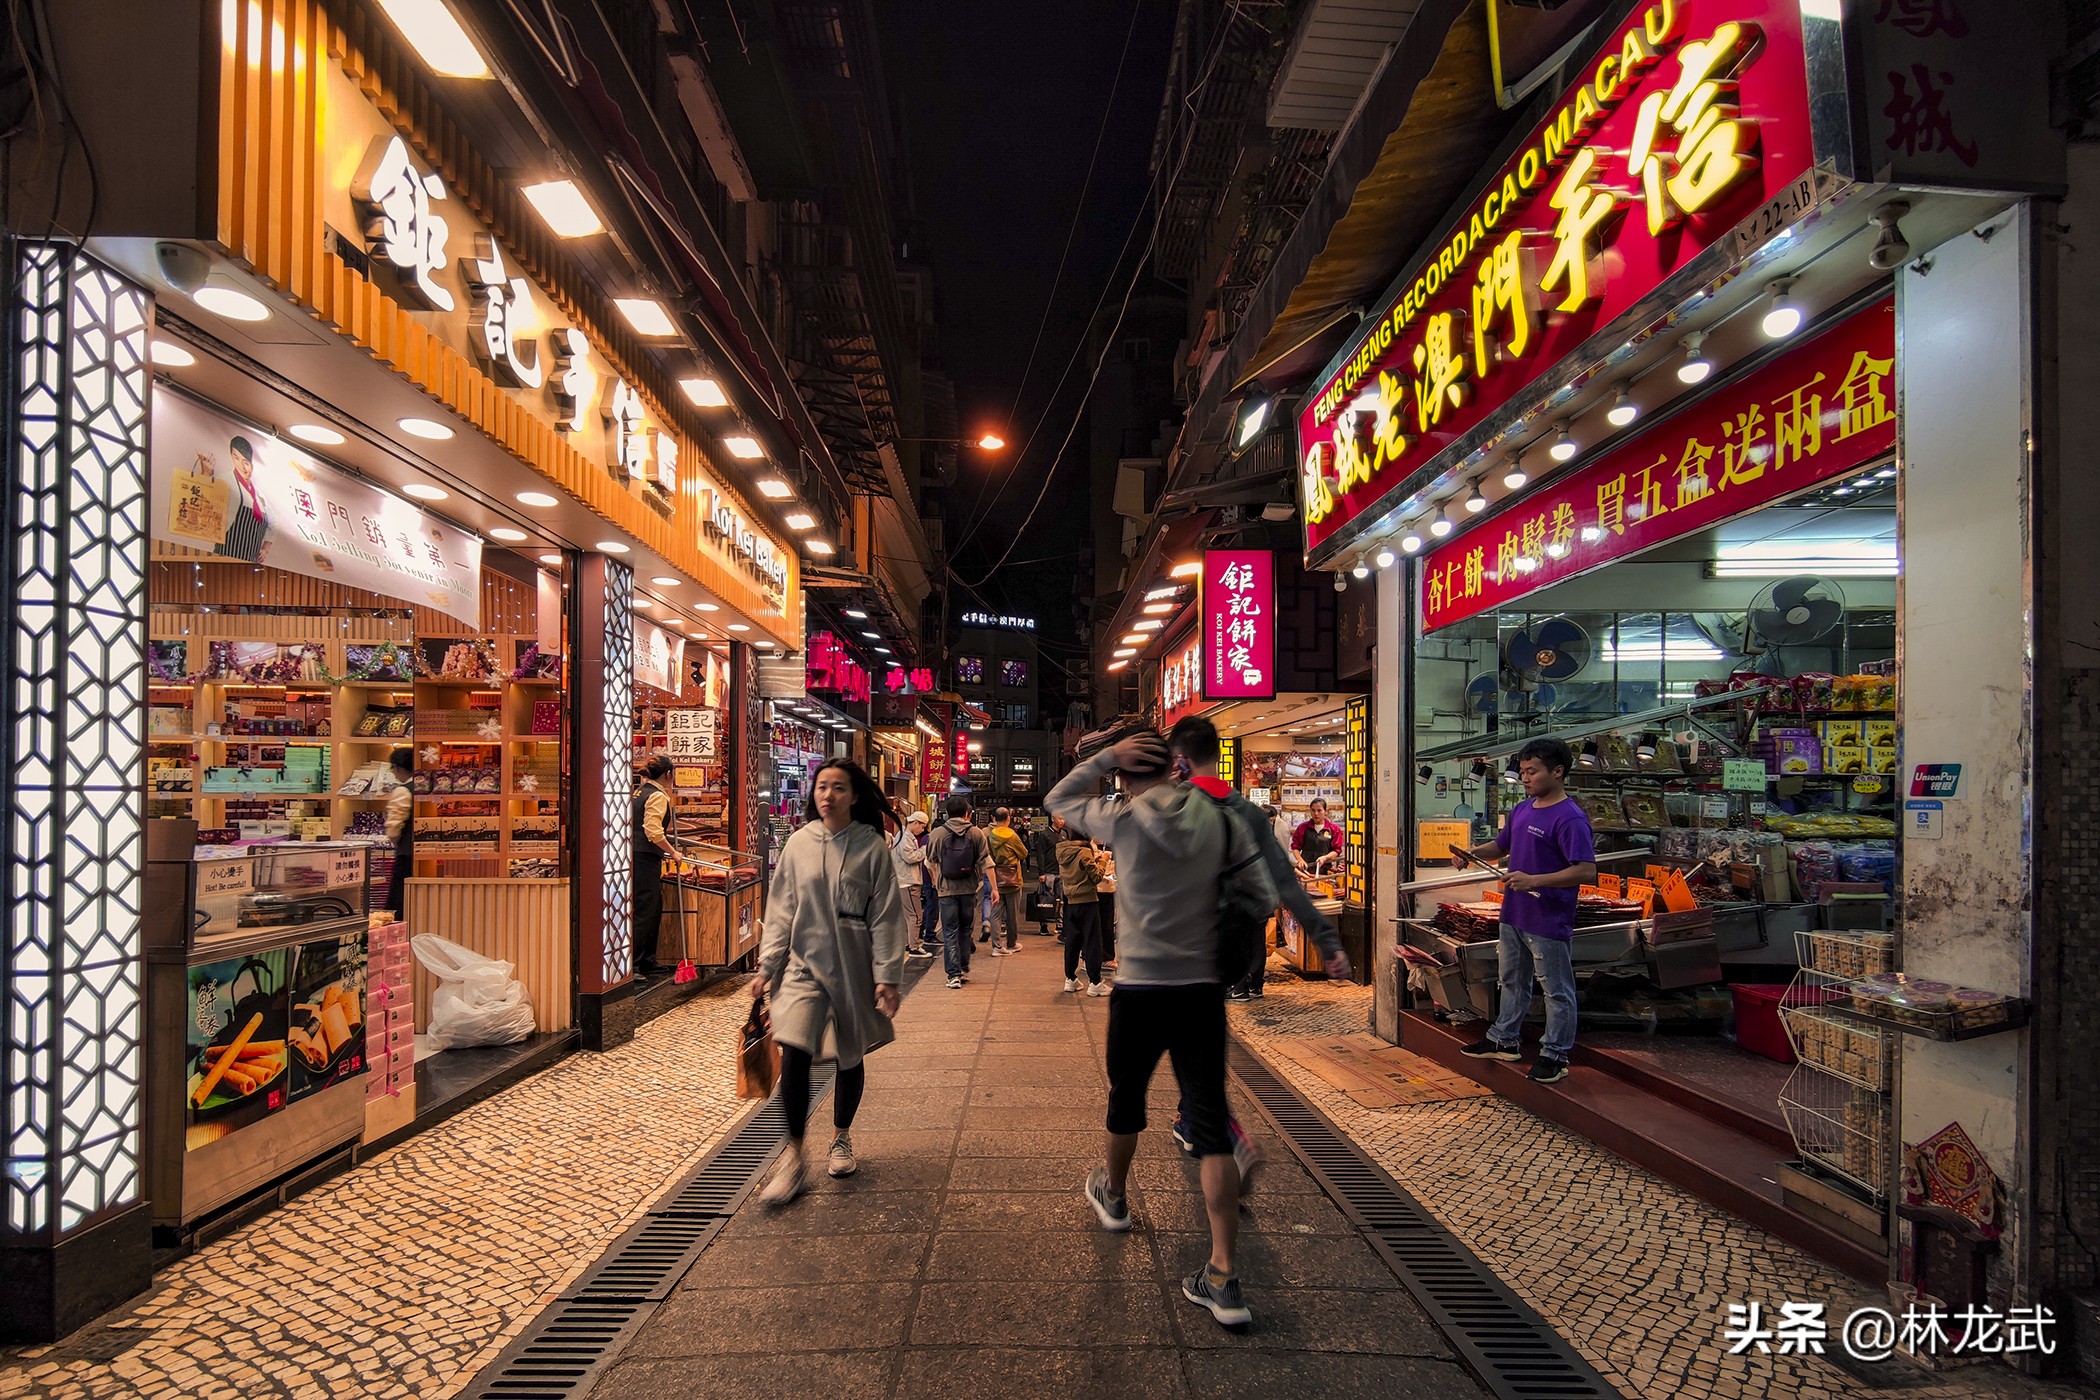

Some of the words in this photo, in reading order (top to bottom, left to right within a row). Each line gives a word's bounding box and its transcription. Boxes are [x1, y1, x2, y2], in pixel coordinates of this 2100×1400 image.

[1314, 382, 1343, 428] FENG
[1344, 321, 1391, 391] CHENG
[1543, 0, 1673, 161] MACAU
[1763, 180, 1811, 236] 22-AB
[1596, 350, 1896, 538] 買五盒送兩盒
[711, 488, 733, 539] Koi
[735, 515, 754, 558] Kei
[1427, 545, 1485, 616] 杏仁餅
[1218, 560, 1261, 672] 鉅記餅家
[669, 712, 713, 730] 鉅記
[669, 736, 713, 754] 餅家
[1914, 771, 1958, 784] UnionPay
